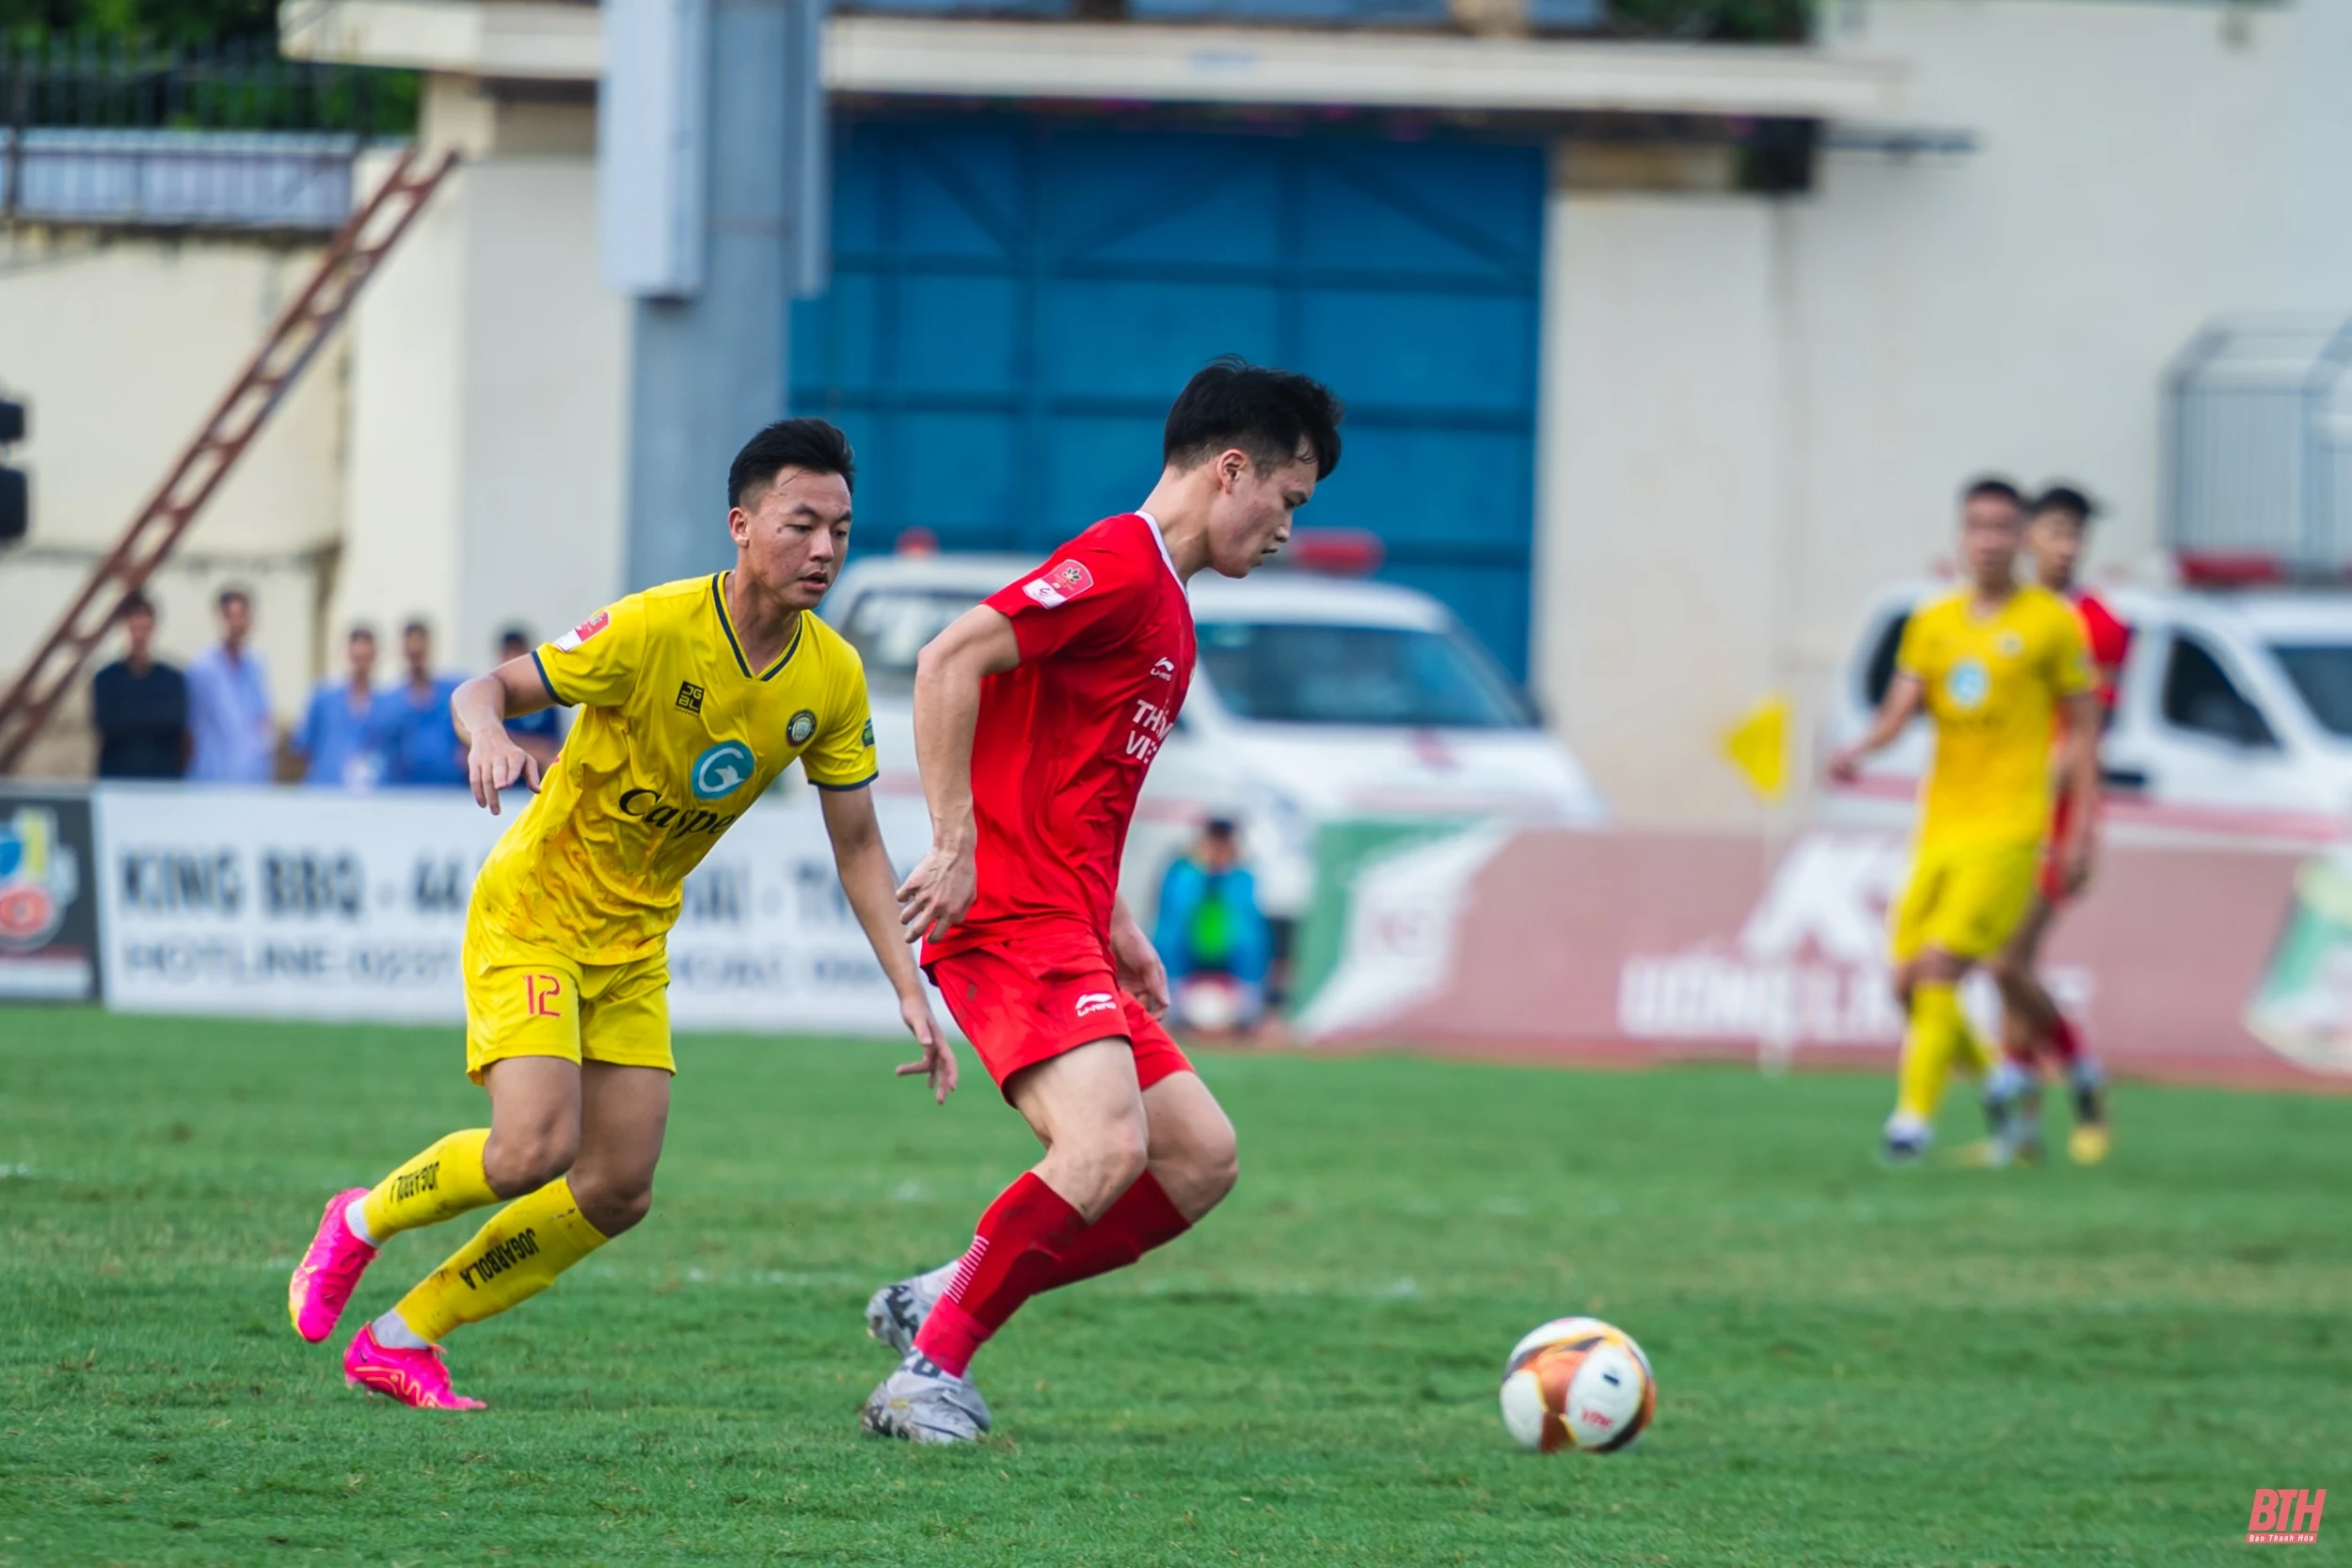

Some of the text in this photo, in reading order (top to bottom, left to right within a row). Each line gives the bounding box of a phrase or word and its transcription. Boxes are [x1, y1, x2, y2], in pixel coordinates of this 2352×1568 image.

[619, 788, 736, 839] Caspe
[522, 974, 561, 1017] 12
[459, 1227, 540, 1291] JOGARBOLA
